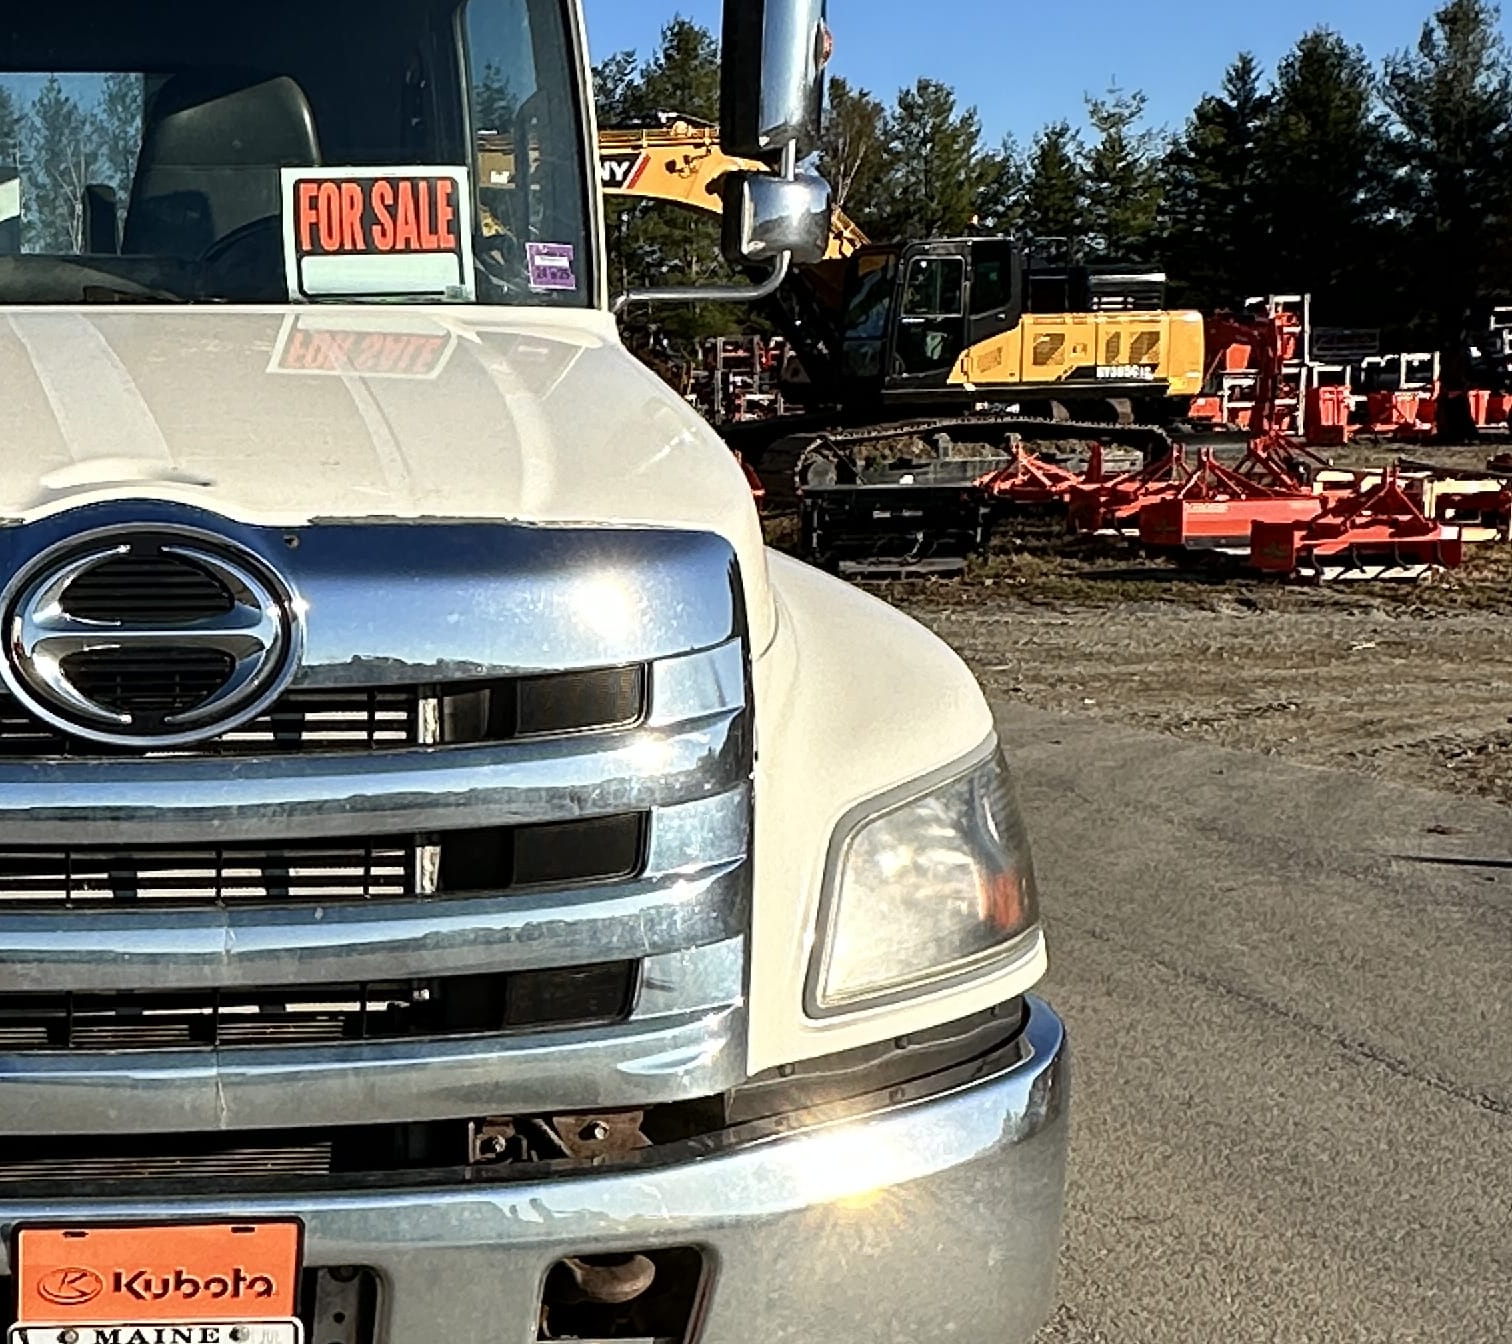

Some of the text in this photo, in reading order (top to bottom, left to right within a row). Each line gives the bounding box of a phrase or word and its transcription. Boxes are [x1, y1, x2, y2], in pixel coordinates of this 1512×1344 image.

[298, 179, 457, 252] FOR SALE
[112, 1267, 275, 1301] Kubota
